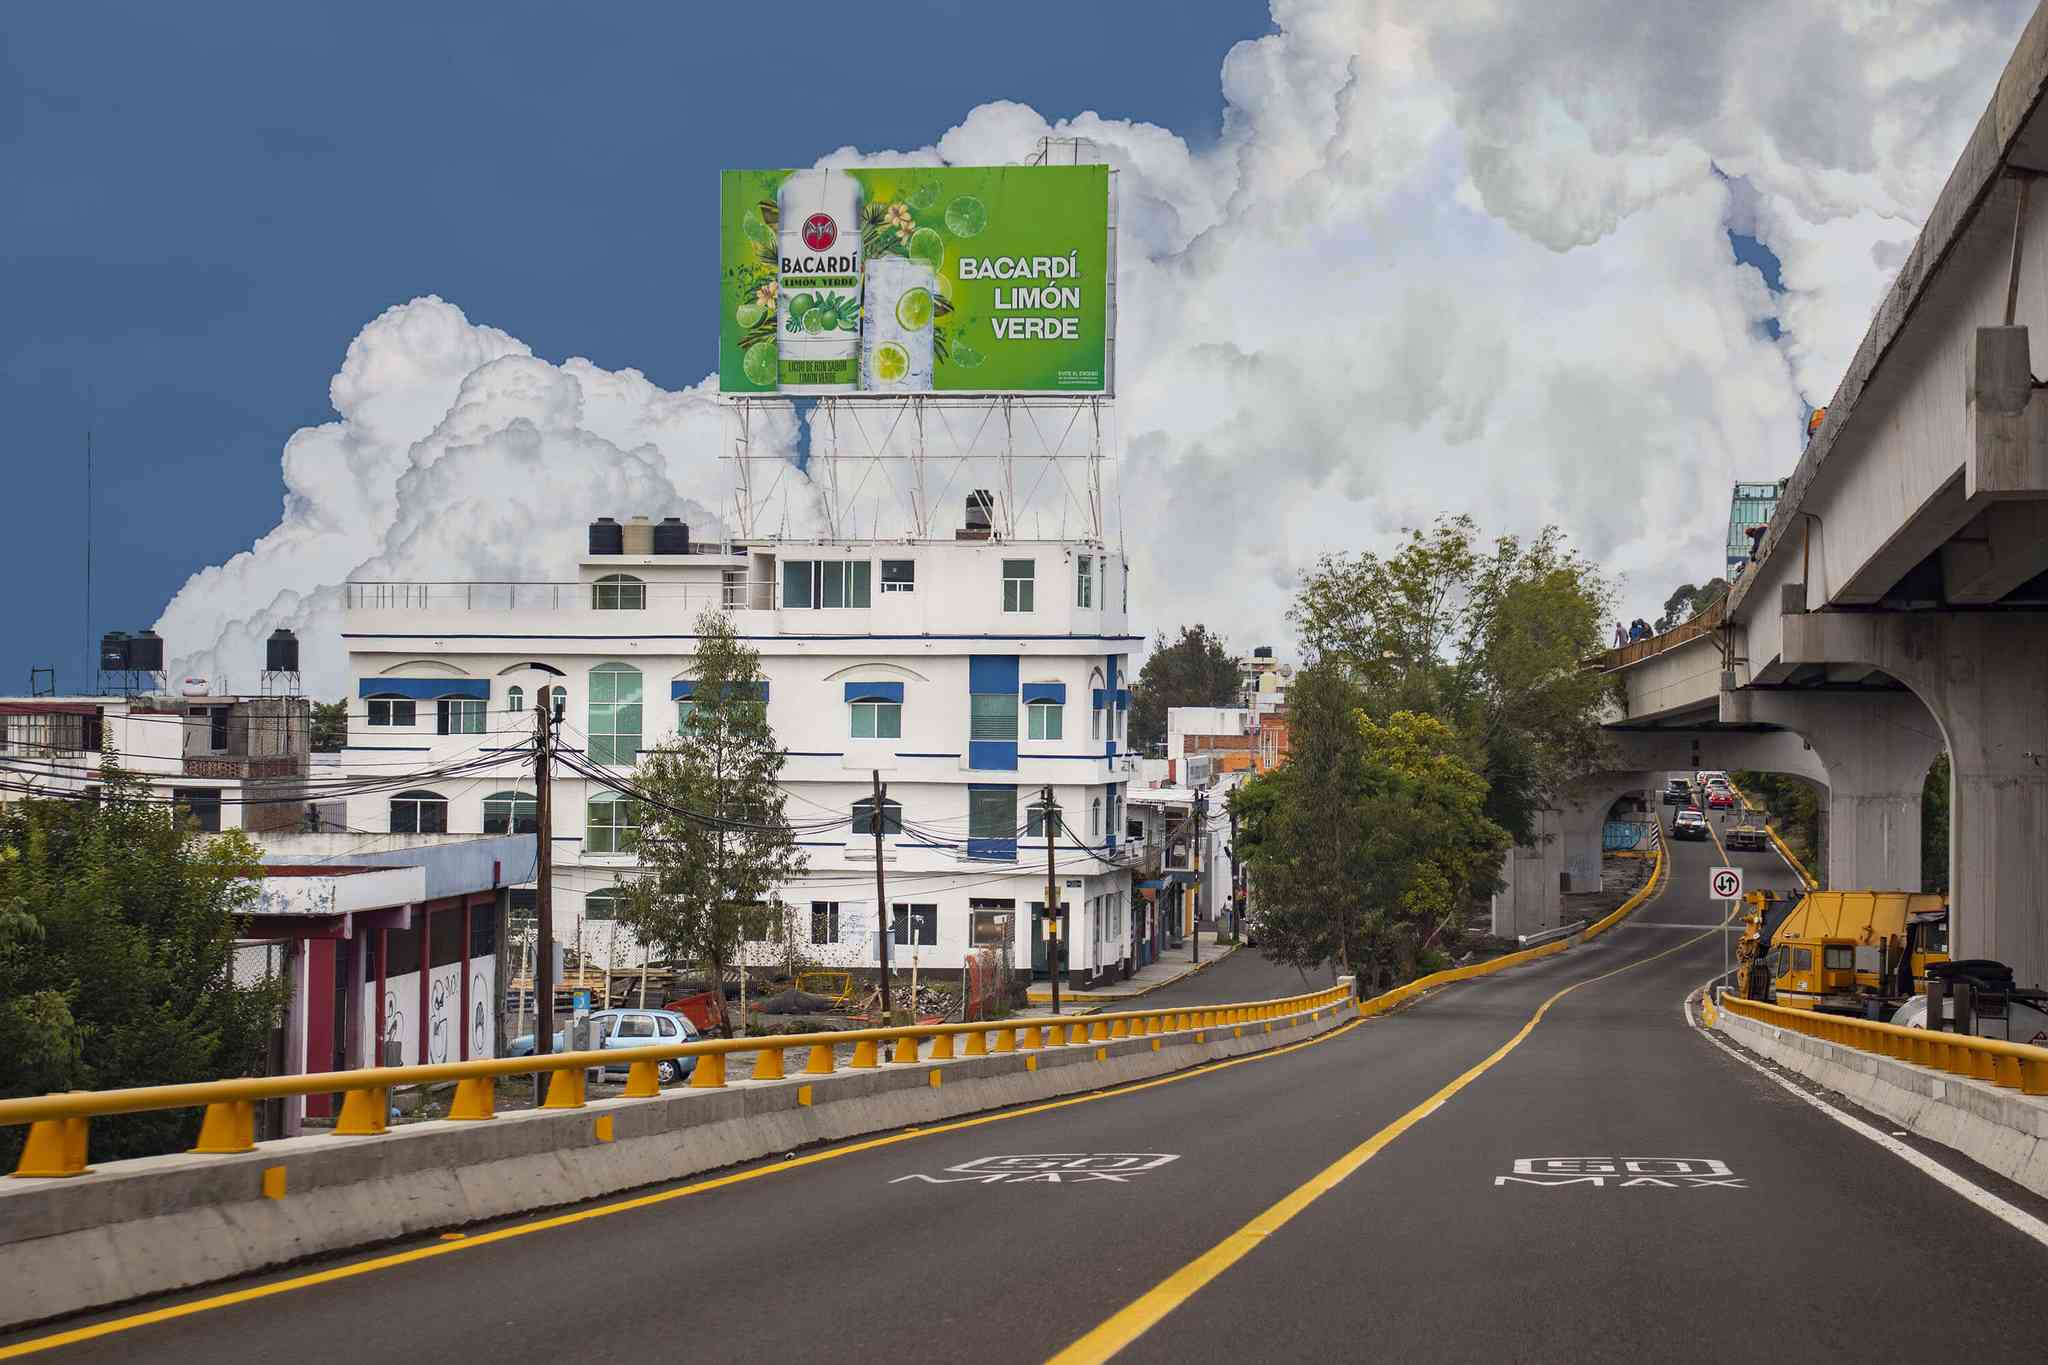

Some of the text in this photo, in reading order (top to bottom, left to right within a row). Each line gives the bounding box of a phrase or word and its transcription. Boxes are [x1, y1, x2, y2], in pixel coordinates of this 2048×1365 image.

[781, 250, 857, 273] BACARDÍ
[959, 249, 1077, 280] BACARDÍ
[994, 281, 1080, 309] LIMÓN
[991, 317, 1079, 339] VERDE
[888, 1172, 1150, 1184] MAX
[1494, 1176, 1750, 1188] MAX
